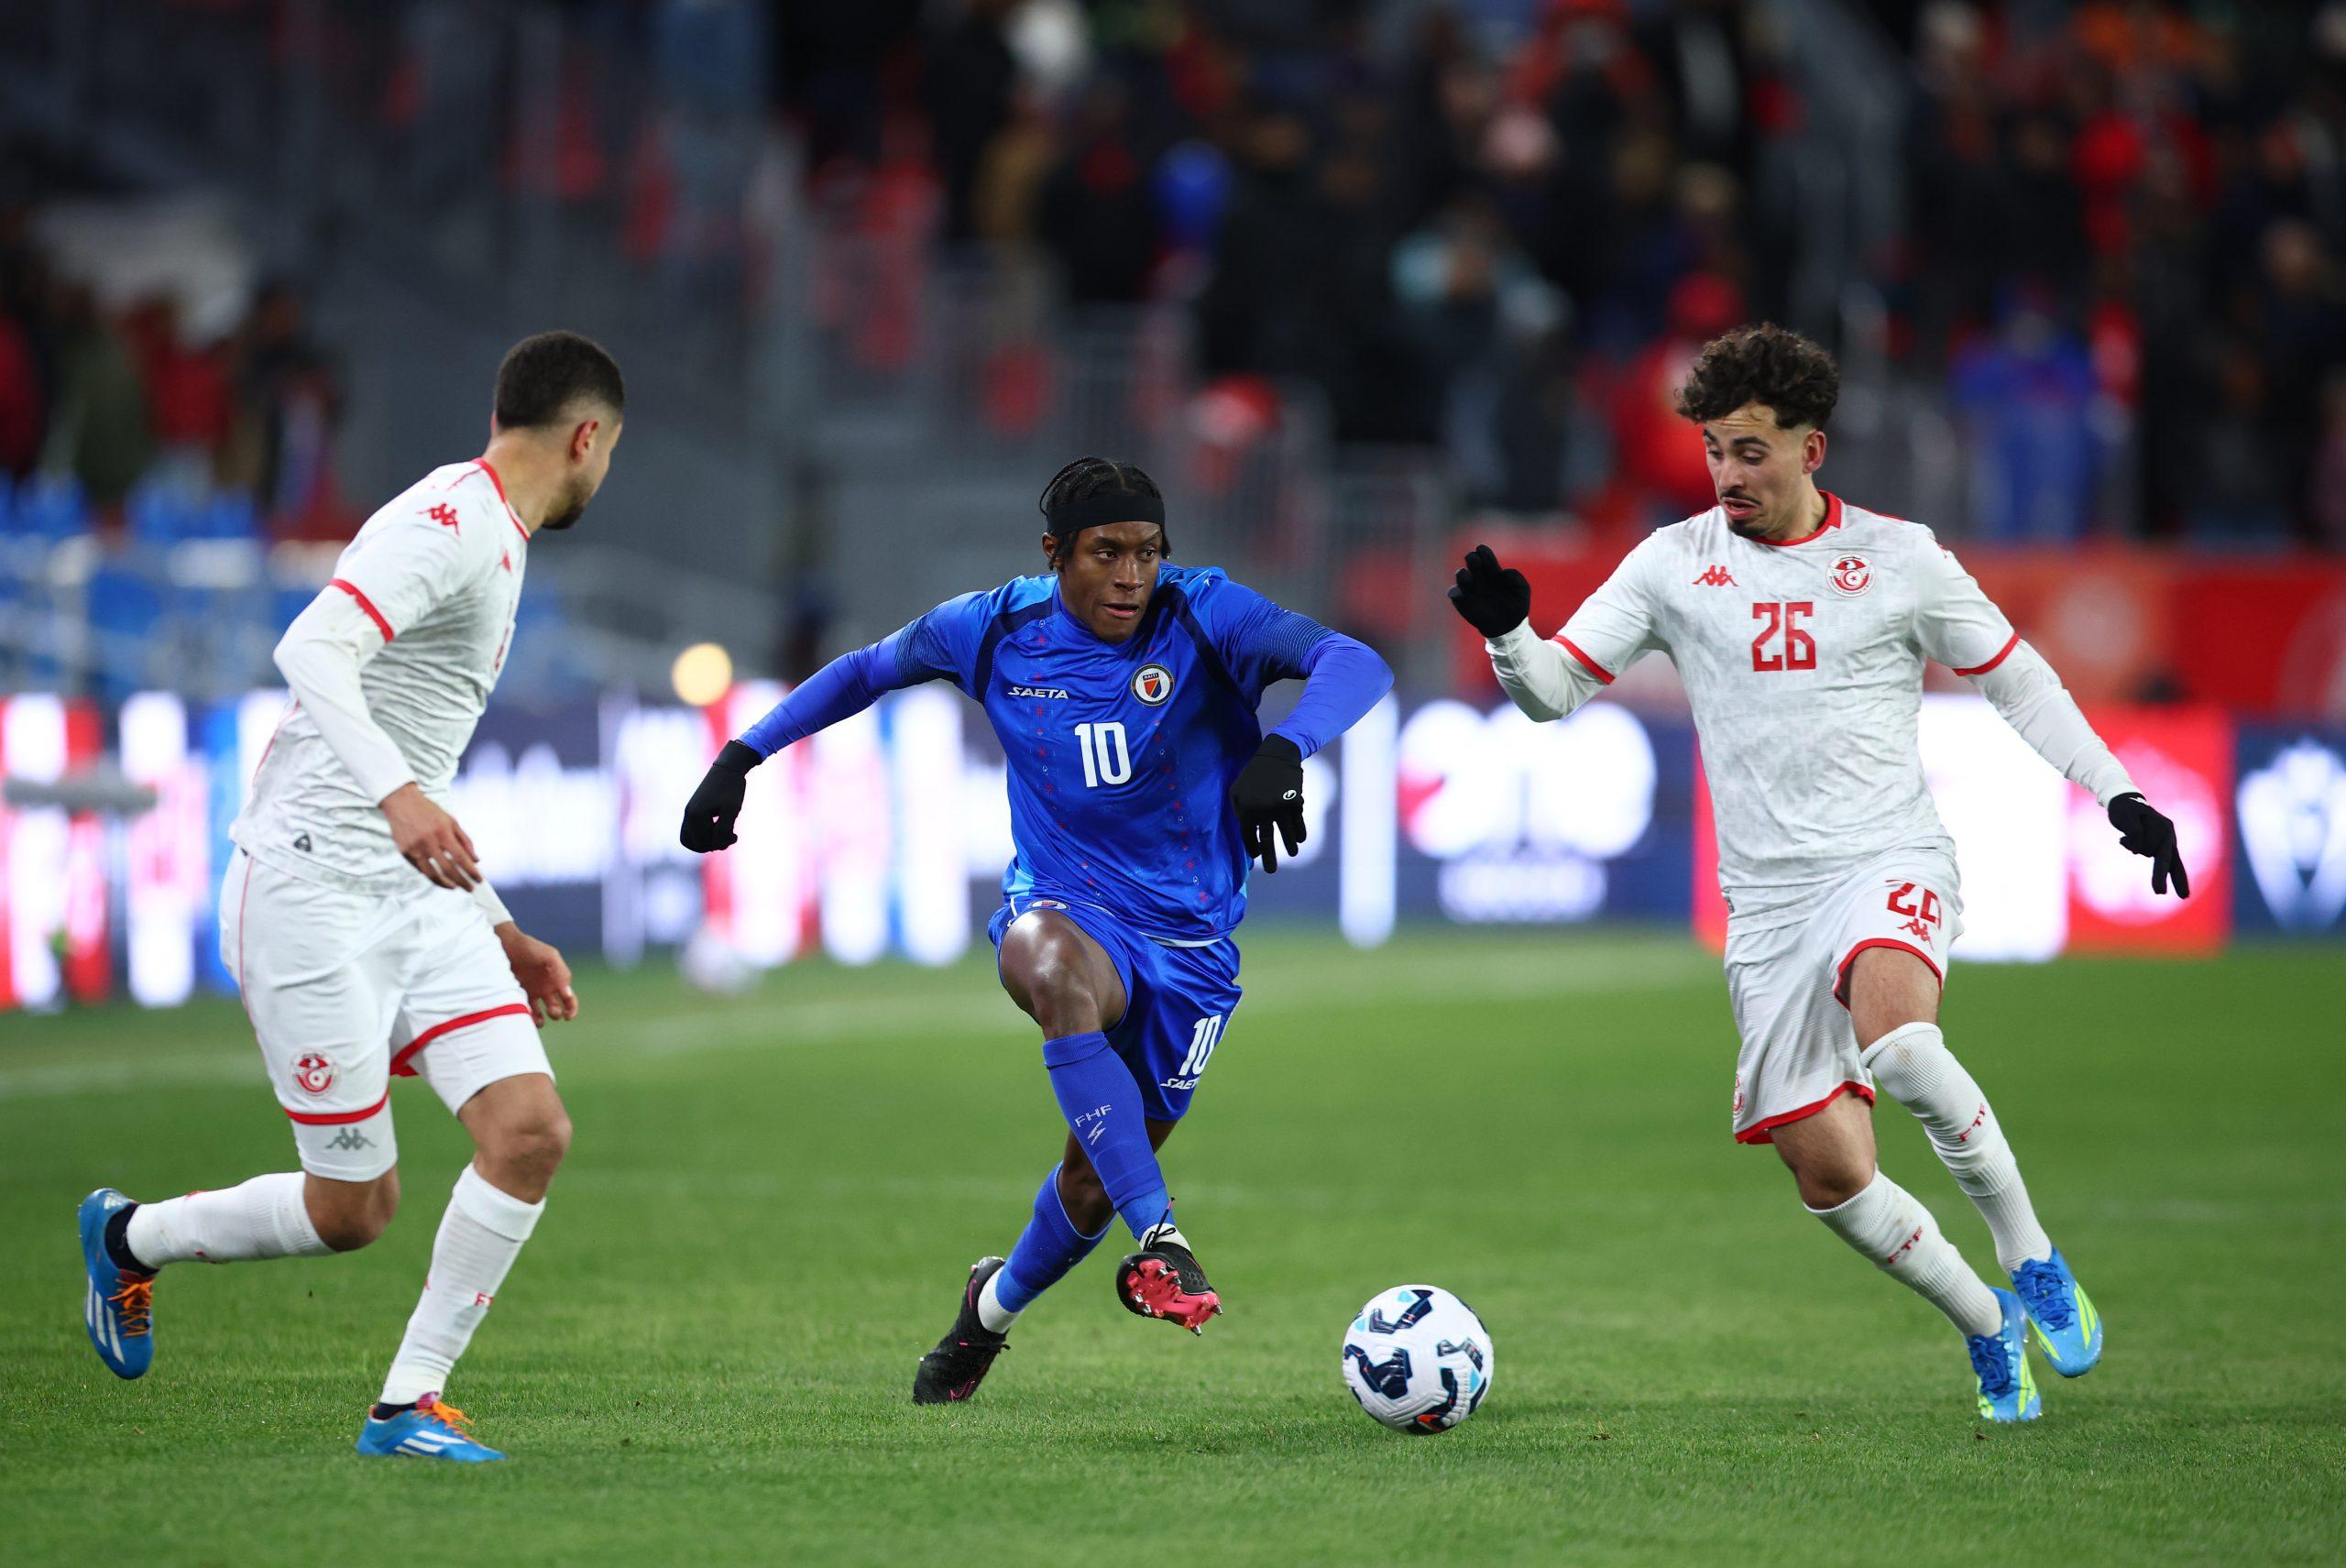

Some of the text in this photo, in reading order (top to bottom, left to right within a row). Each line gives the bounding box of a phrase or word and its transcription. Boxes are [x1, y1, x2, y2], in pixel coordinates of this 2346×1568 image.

[1751, 601, 1816, 672] 26
[1007, 686, 1069, 699] SAETA
[1074, 721, 1132, 787] 10
[1178, 1014, 1222, 1076] 10
[1159, 1078, 1200, 1090] SAET
[1075, 1104, 1112, 1127] FHF
[1959, 1102, 1986, 1142] FTF
[1888, 1225, 1923, 1264] FTF
